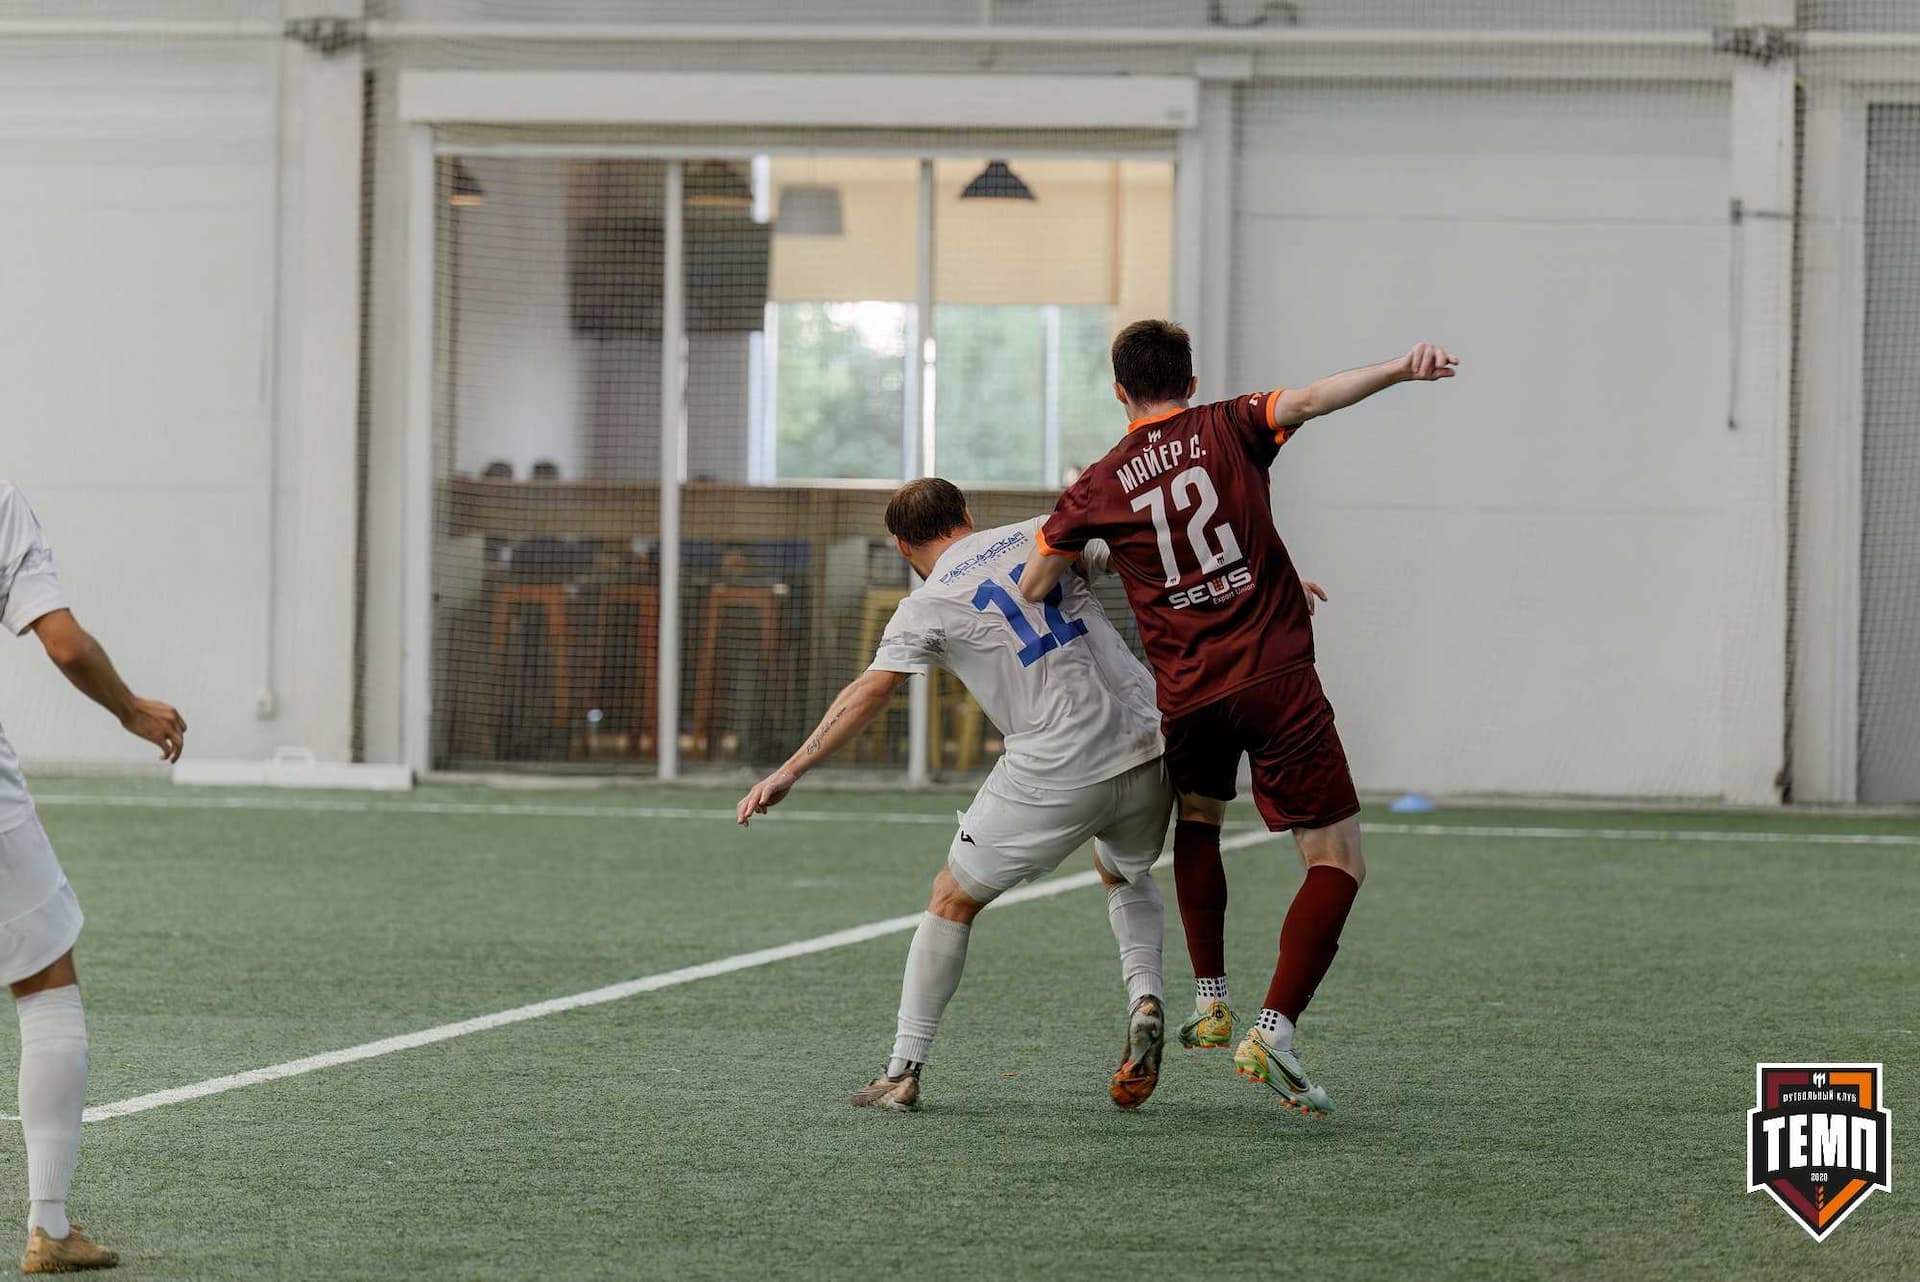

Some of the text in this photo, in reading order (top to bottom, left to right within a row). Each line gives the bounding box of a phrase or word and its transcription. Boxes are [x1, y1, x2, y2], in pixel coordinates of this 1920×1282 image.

[1116, 440, 1183, 494] МАЙЕР
[1130, 465, 1243, 589] 72
[1168, 566, 1252, 610] SEUS
[1212, 591, 1235, 605] Export
